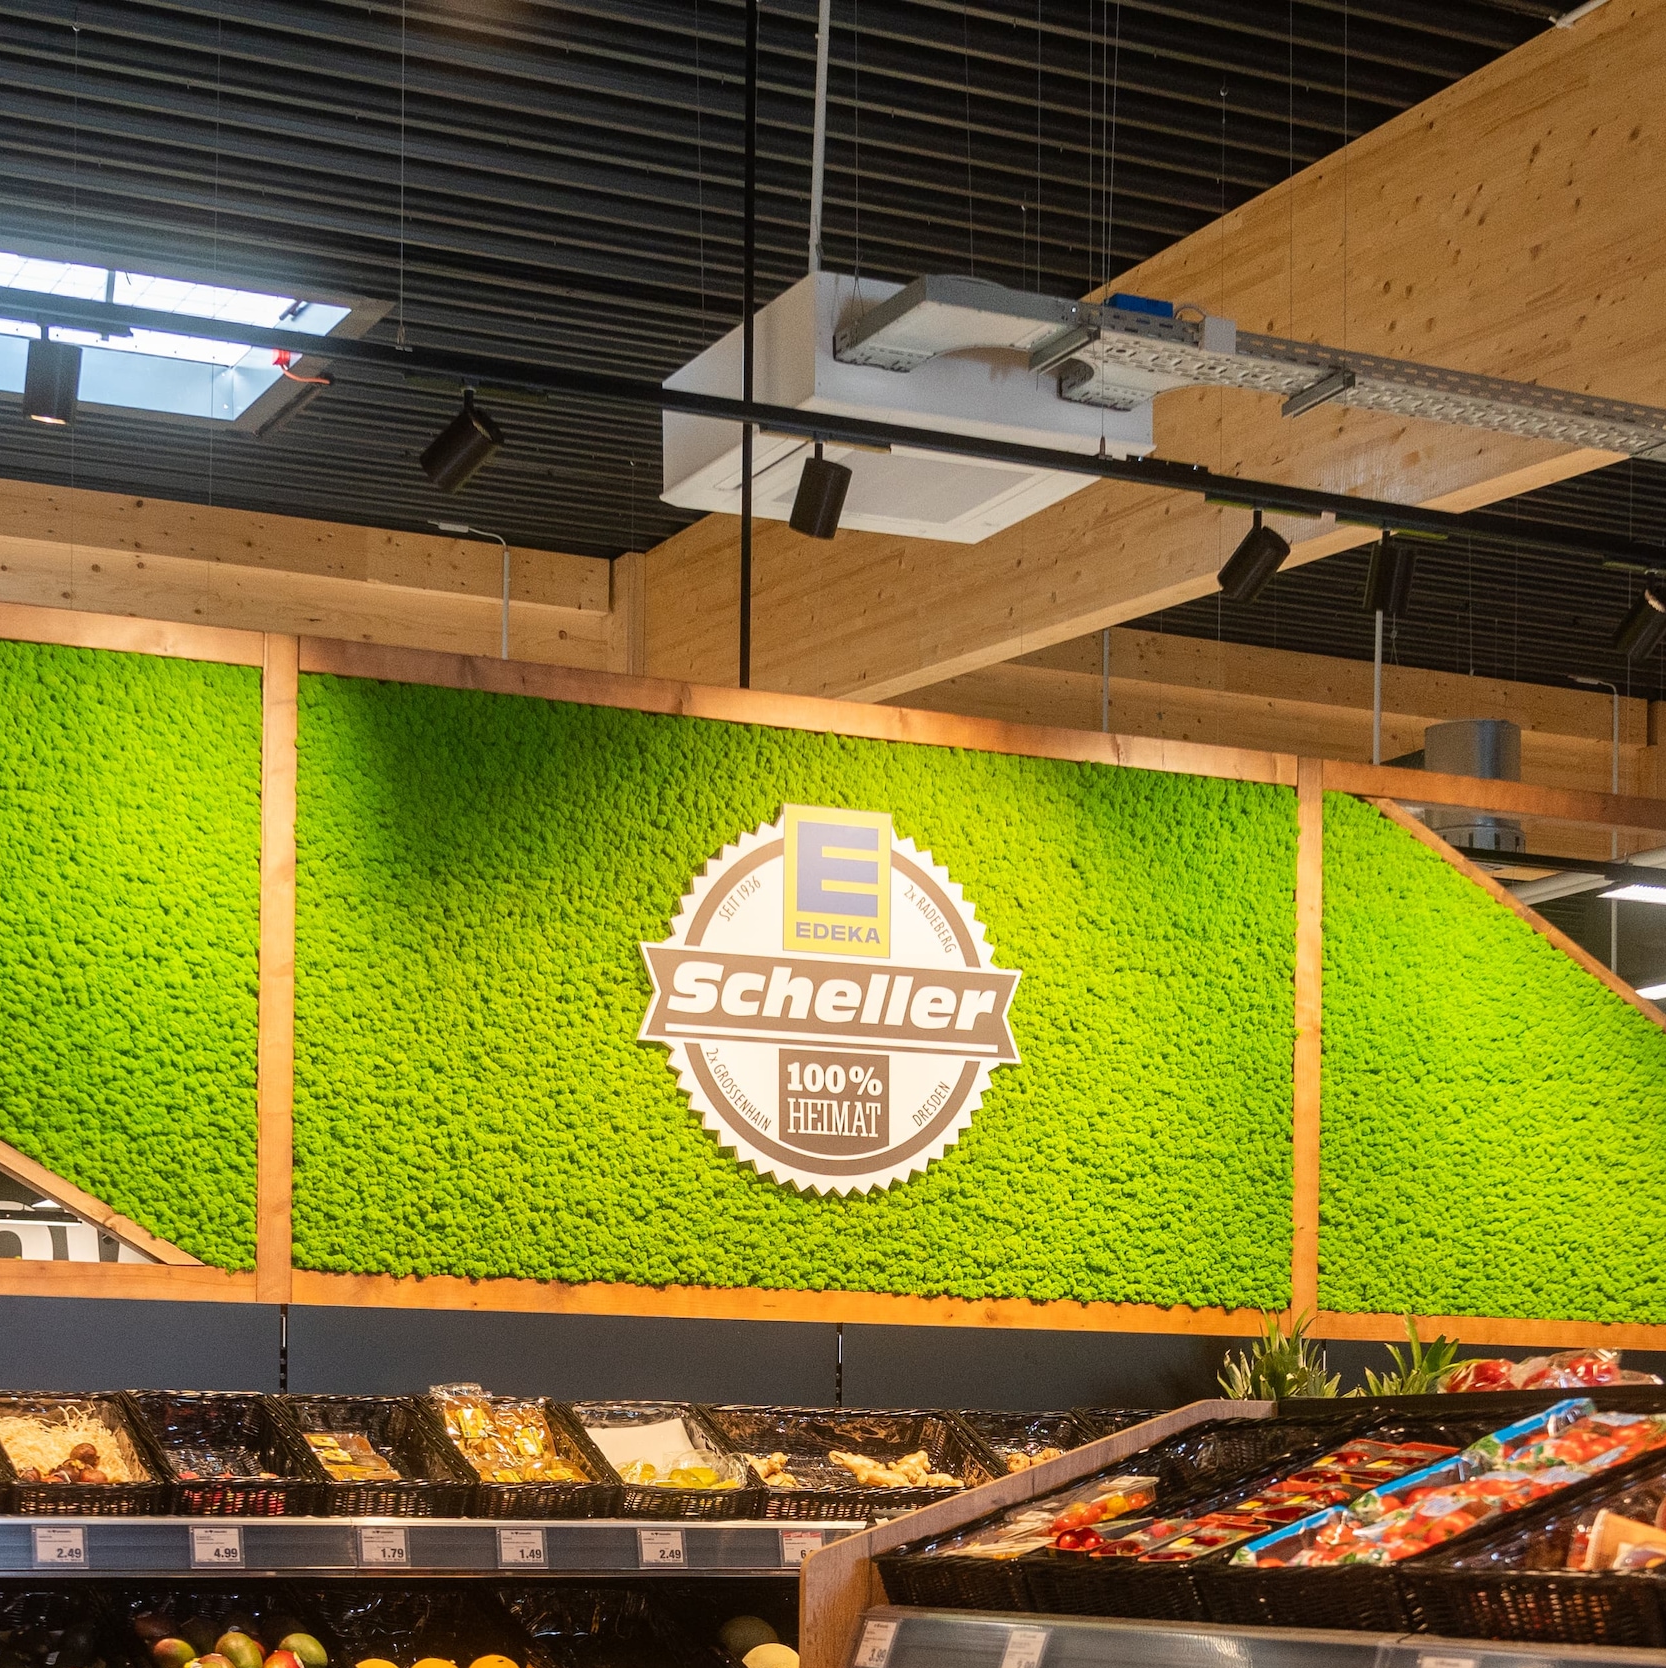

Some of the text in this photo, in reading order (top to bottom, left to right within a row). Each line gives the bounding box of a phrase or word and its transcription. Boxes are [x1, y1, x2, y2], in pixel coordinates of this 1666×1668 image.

[797, 821, 879, 918] E
[719, 875, 761, 922] SEIT 1936
[796, 921, 881, 945] EDEKA
[904, 884, 957, 953] 2x RADEBERG
[667, 961, 997, 1031] Scheller
[706, 1048, 772, 1132] 2x GROSSENHAIN
[787, 1061, 883, 1096] 100%
[787, 1098, 881, 1138] HEIMAT
[912, 1081, 950, 1127] DRESDEN
[56, 1548, 82, 1559] 2.49
[213, 1548, 238, 1558] 4.99
[381, 1548, 404, 1558] 1.79
[519, 1549, 542, 1559] 1.49
[659, 1549, 681, 1559] 2.49
[869, 1648, 887, 1663] 3.99
